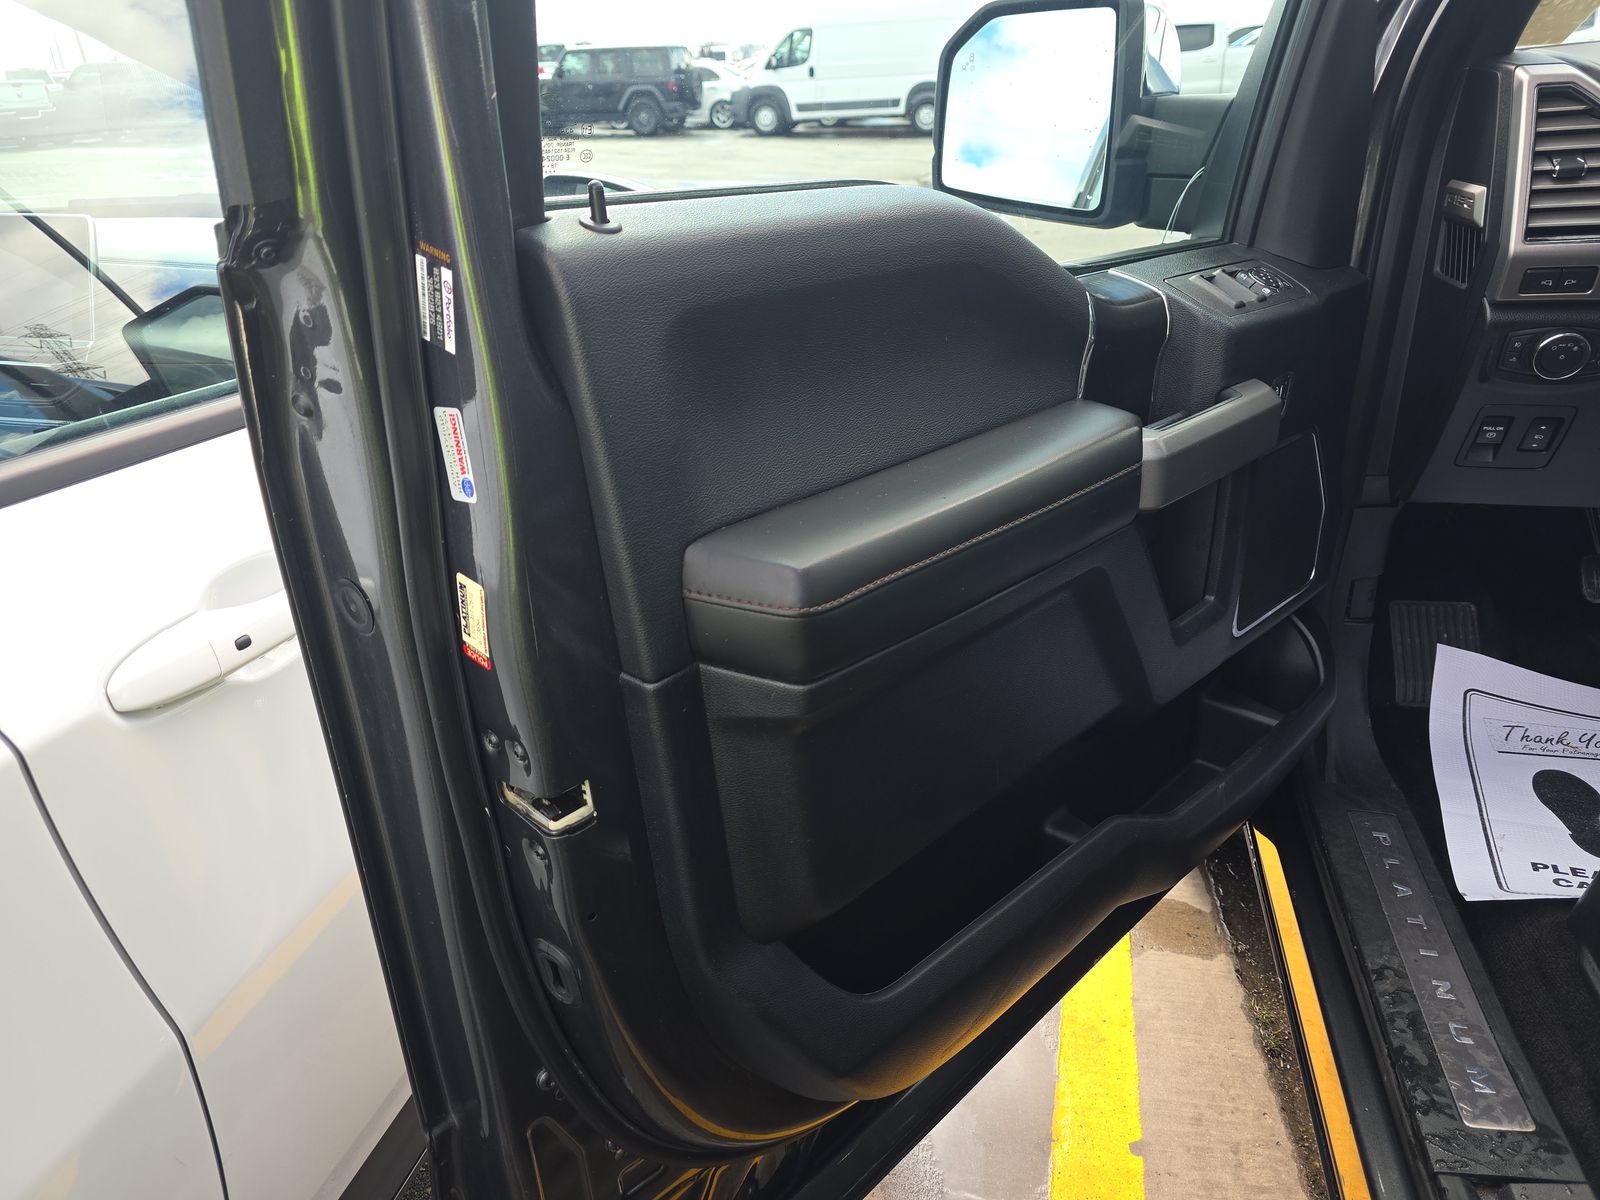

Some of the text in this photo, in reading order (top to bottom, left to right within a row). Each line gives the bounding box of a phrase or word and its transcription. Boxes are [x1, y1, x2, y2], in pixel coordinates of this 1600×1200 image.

[419, 241, 451, 263] WARNING
[449, 413, 466, 475] WARNING!
[458, 582, 468, 635] PLATINUM
[1502, 725, 1570, 747] Thank
[1540, 745, 1559, 754] Your
[1372, 831, 1496, 1094] PLATINUM
